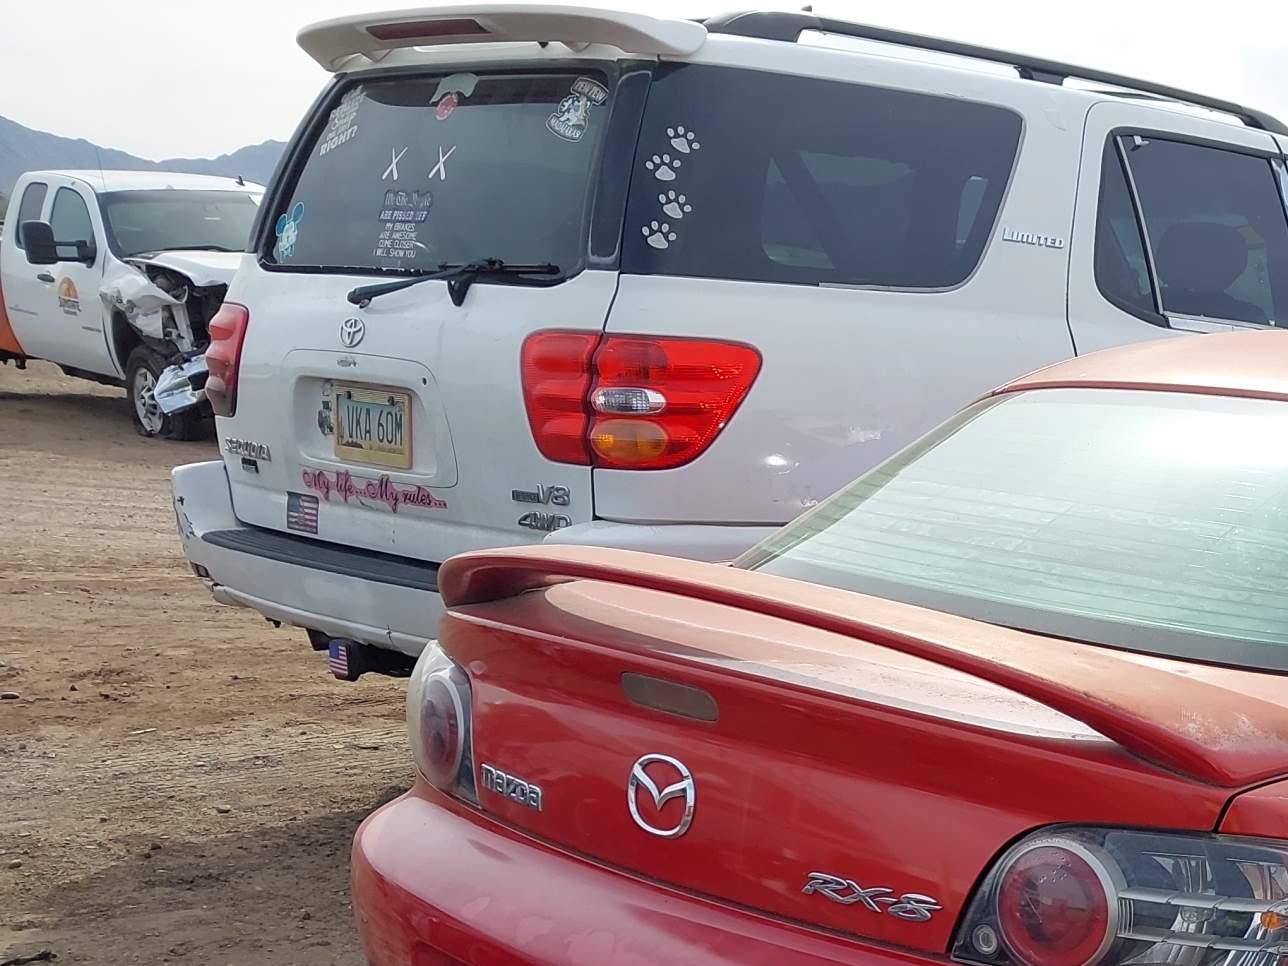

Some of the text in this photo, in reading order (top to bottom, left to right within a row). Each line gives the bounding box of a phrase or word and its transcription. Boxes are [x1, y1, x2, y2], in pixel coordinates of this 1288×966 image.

[319, 125, 358, 157] RIGHT?
[1002, 228, 1064, 250] LIMITED
[346, 404, 372, 441] VKA
[224, 437, 272, 462] SEQUOIA
[536, 483, 571, 506] V8
[518, 511, 573, 532] 4WD
[801, 871, 943, 922] RX-8
